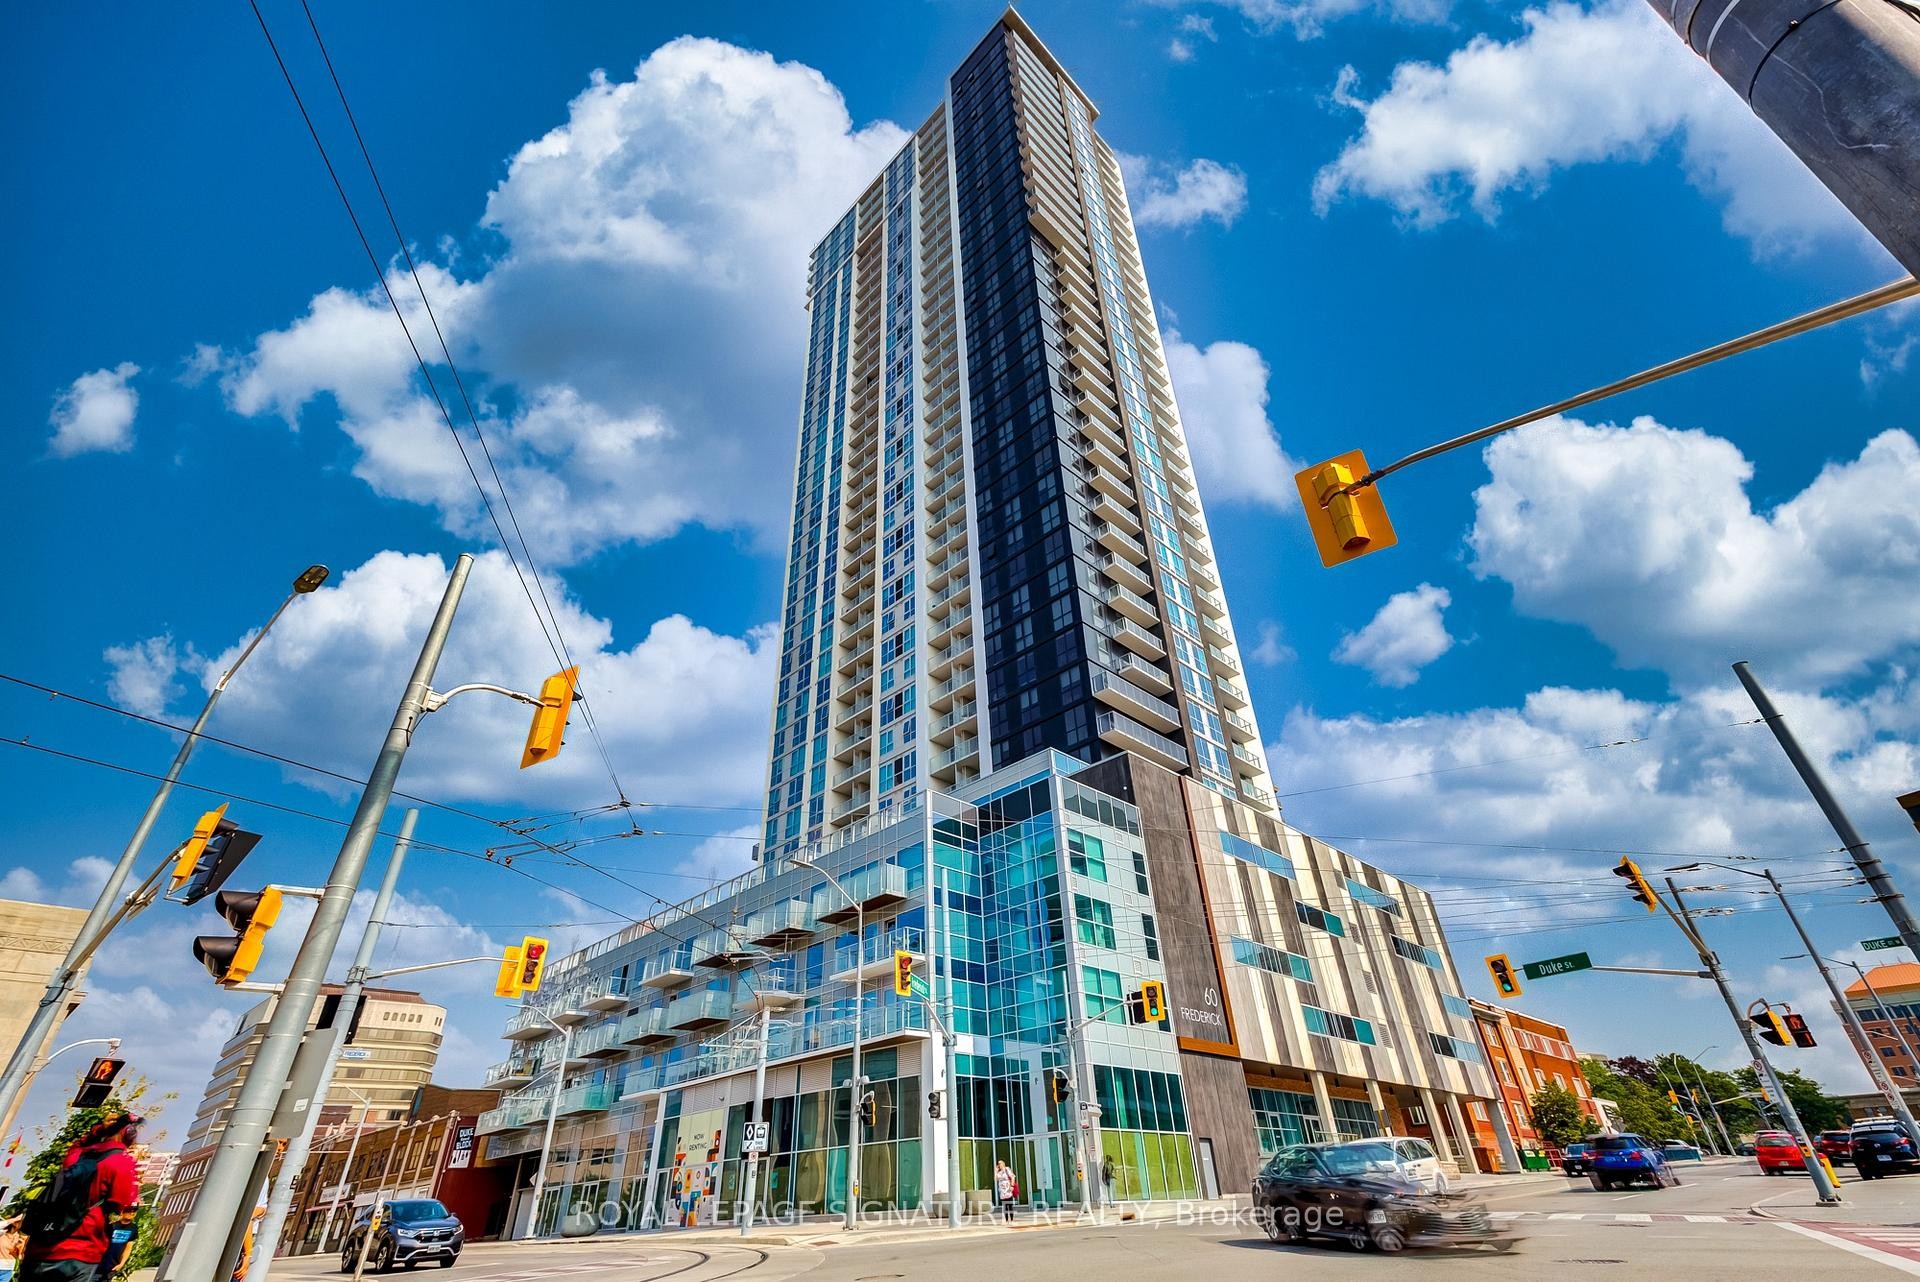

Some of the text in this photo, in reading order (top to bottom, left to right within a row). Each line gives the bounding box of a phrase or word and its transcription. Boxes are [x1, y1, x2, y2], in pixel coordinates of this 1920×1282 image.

[1863, 940, 1888, 950] DUKE
[1539, 961, 1564, 975] Duke
[1204, 987, 1218, 1007] 60
[1180, 1006, 1222, 1026] FREDERICK
[459, 1128, 474, 1137] DUKE
[456, 1141, 472, 1150] BLOCK
[688, 1142, 708, 1151] RENTING
